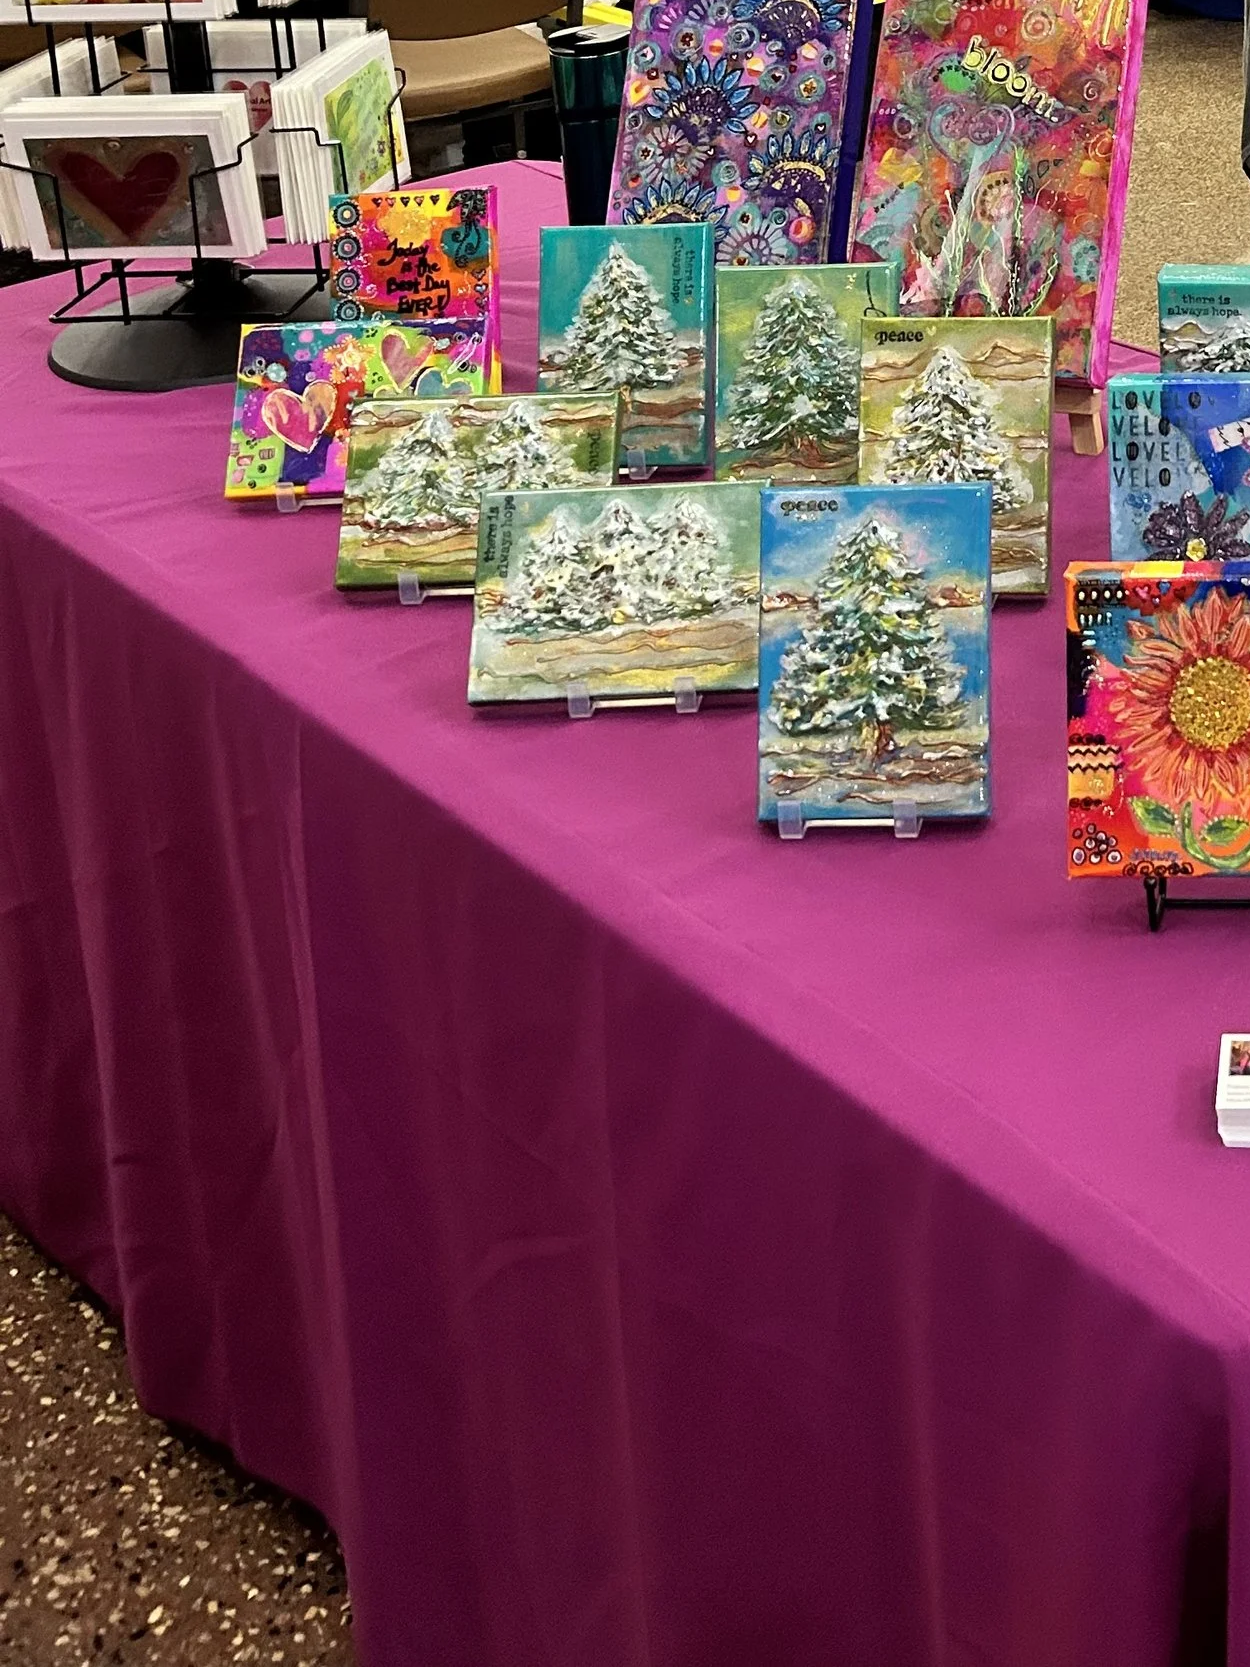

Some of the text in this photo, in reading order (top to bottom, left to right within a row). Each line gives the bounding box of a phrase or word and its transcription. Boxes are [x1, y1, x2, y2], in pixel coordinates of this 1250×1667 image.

[961, 35, 1058, 122] bloom
[377, 238, 430, 266] Today
[416, 257, 441, 277] the
[386, 274, 451, 311] Best Day
[1182, 294, 1232, 305] there is
[1167, 305, 1209, 318] always
[874, 330, 925, 346] peace
[780, 500, 839, 517] peace
[484, 523, 498, 562] there
